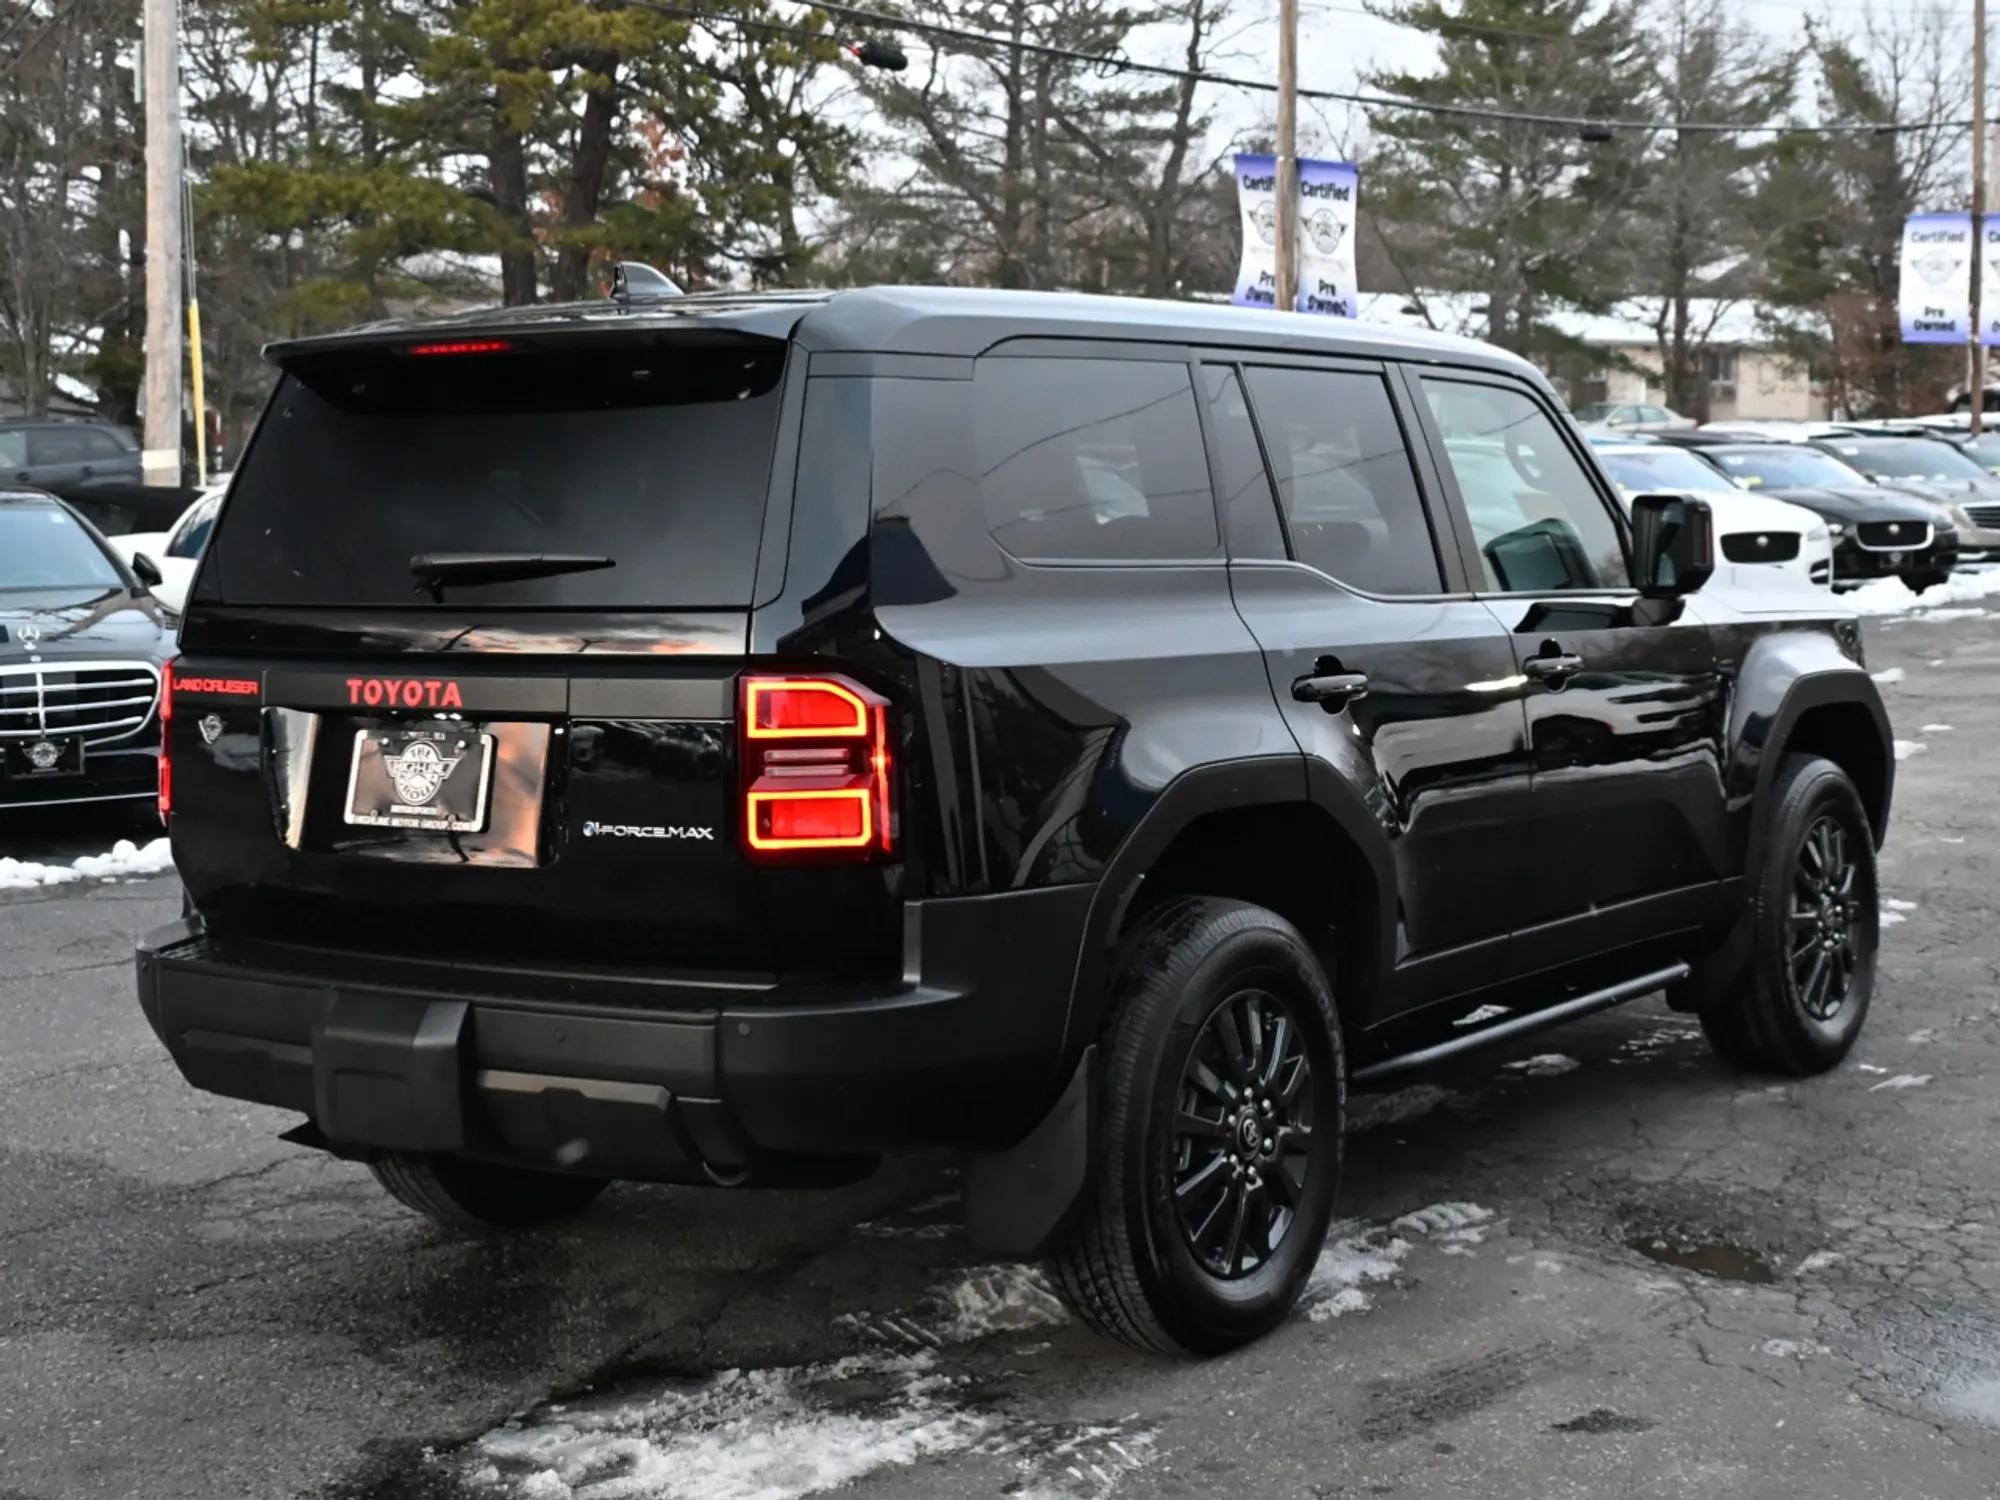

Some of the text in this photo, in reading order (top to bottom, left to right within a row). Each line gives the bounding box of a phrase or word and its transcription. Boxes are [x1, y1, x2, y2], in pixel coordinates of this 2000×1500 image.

[1243, 174, 1275, 192] Certif
[1301, 180, 1350, 202] Certified
[1911, 231, 1965, 243] Certified
[1245, 285, 1275, 305] Owne
[1319, 277, 1337, 297] Pre
[1307, 294, 1348, 317] Owned
[1924, 306, 1945, 318] Pre
[1913, 320, 1956, 332] Owned
[173, 678, 259, 695] LAND CRUISER
[346, 678, 462, 707] TOYOTA
